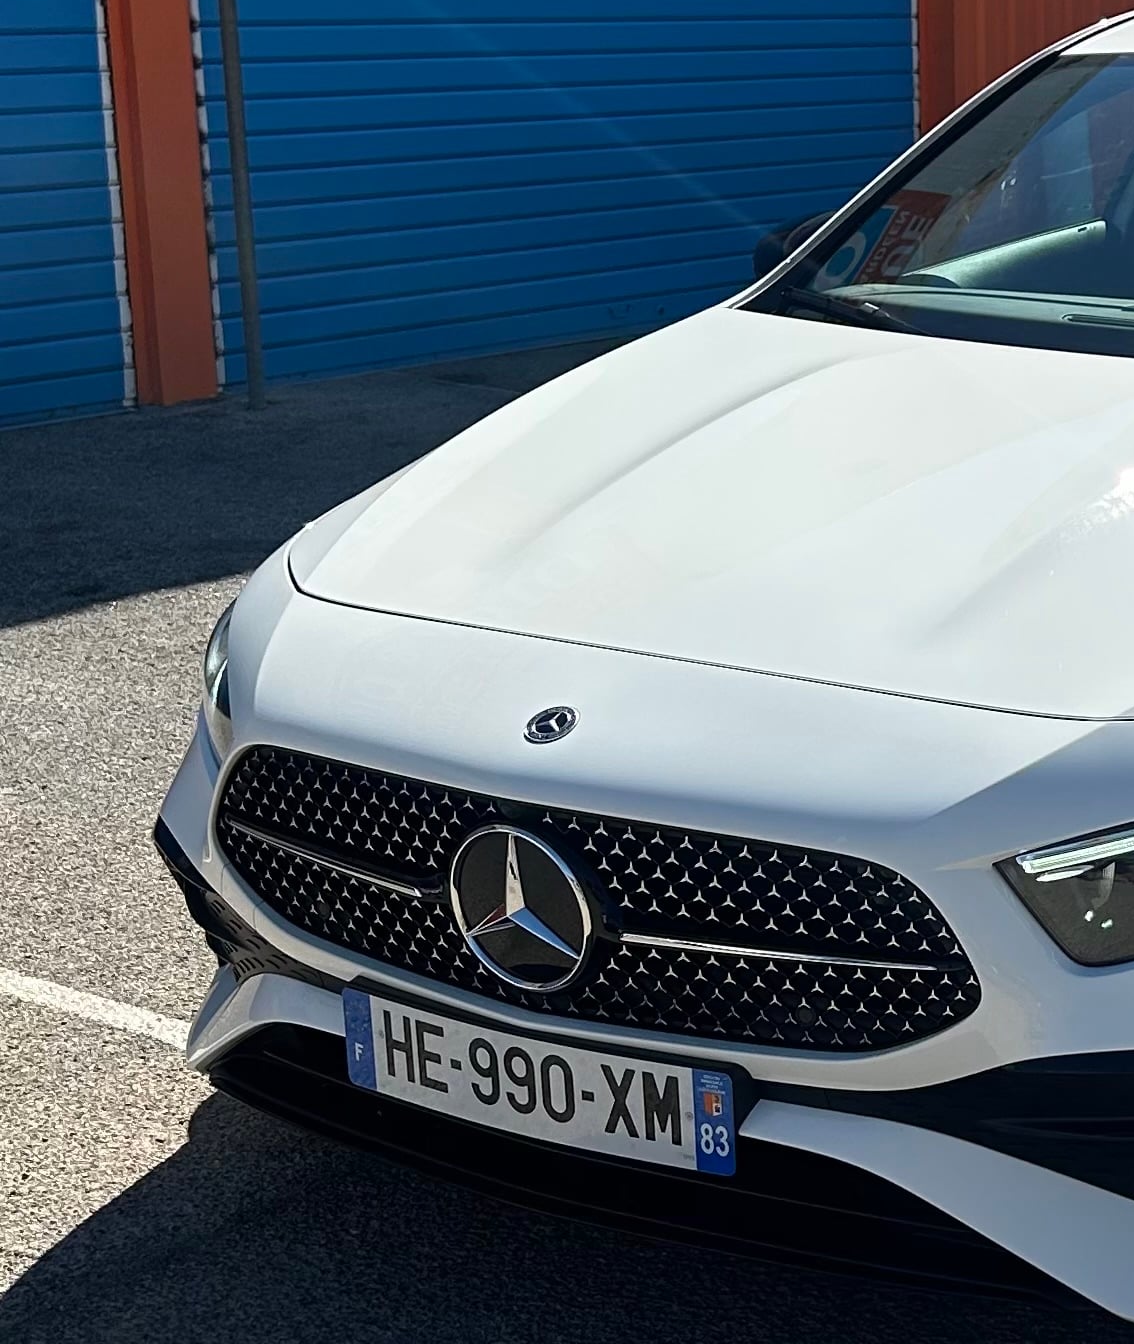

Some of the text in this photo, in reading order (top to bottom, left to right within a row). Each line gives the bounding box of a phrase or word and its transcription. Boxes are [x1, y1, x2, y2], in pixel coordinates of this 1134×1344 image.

[354, 1042, 364, 1062] F
[383, 1009, 682, 1147] HE-990-XM
[700, 1122, 730, 1157] 83
